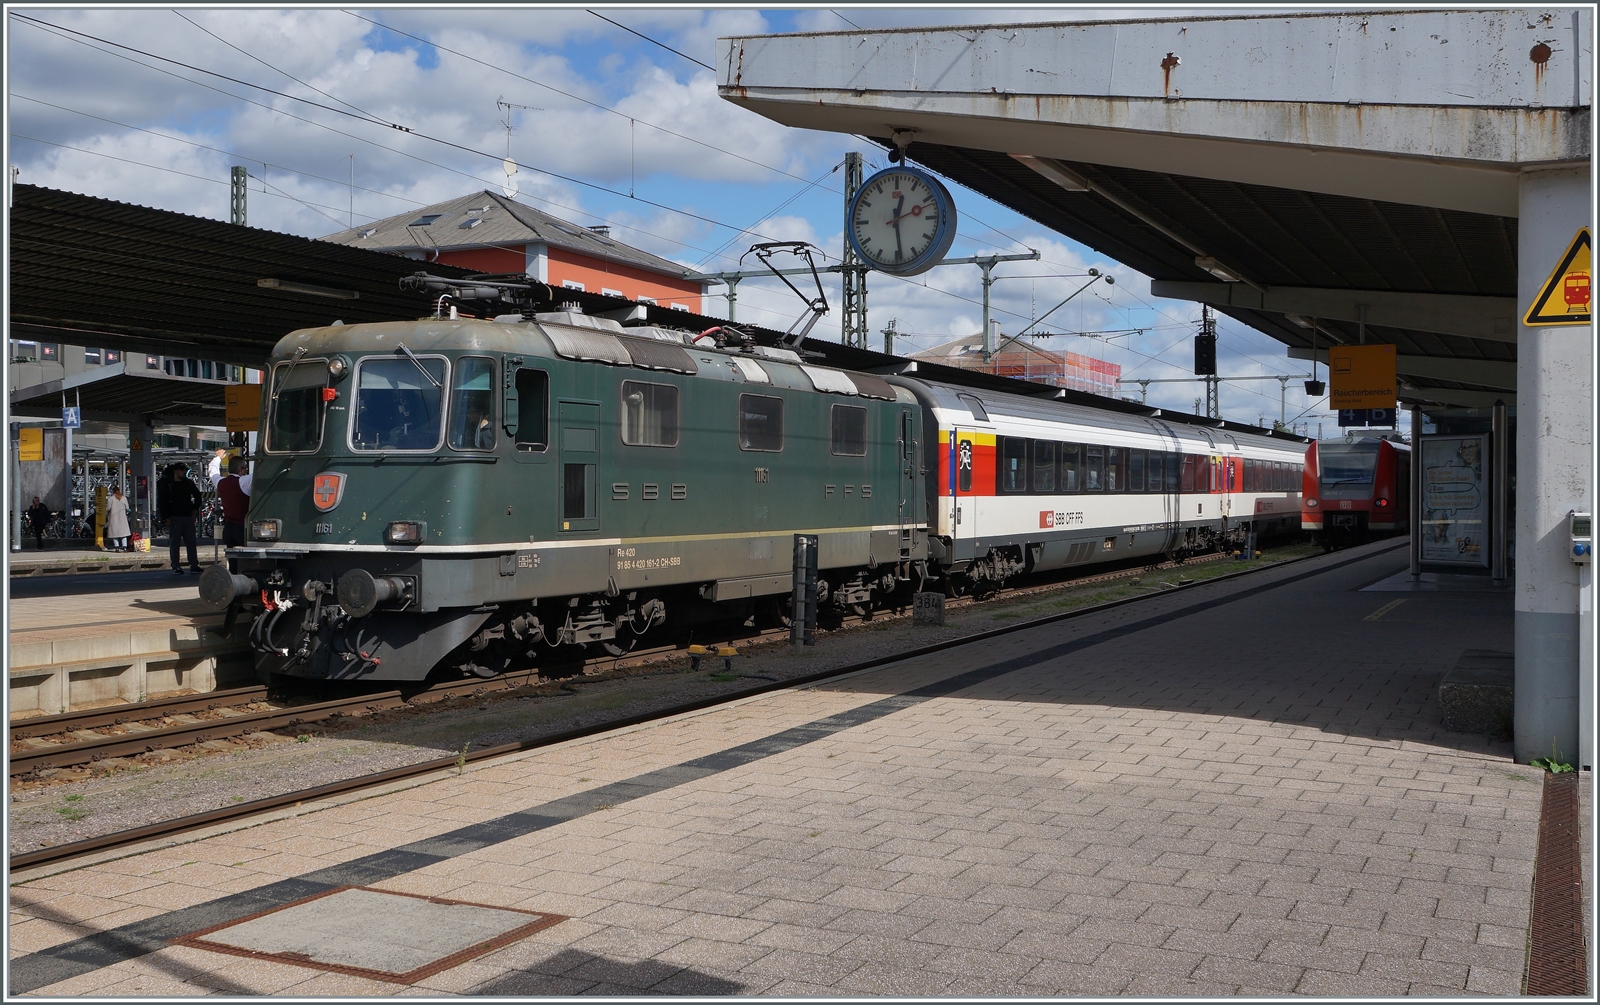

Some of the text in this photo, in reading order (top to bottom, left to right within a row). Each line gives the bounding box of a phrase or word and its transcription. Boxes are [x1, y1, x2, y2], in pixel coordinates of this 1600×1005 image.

[1334, 388, 1392, 397] Raucherbereich
[67, 408, 77, 424] A
[1342, 408, 1386, 421] 4 B
[950, 433, 954, 450] 1
[754, 467, 770, 483] 11161
[1055, 512, 1083, 525] SBB CFF FFS
[617, 548, 636, 557] Re 420
[617, 557, 680, 570] 91 85 4 420 161-2 CH-SBB
[916, 598, 938, 608] 384
